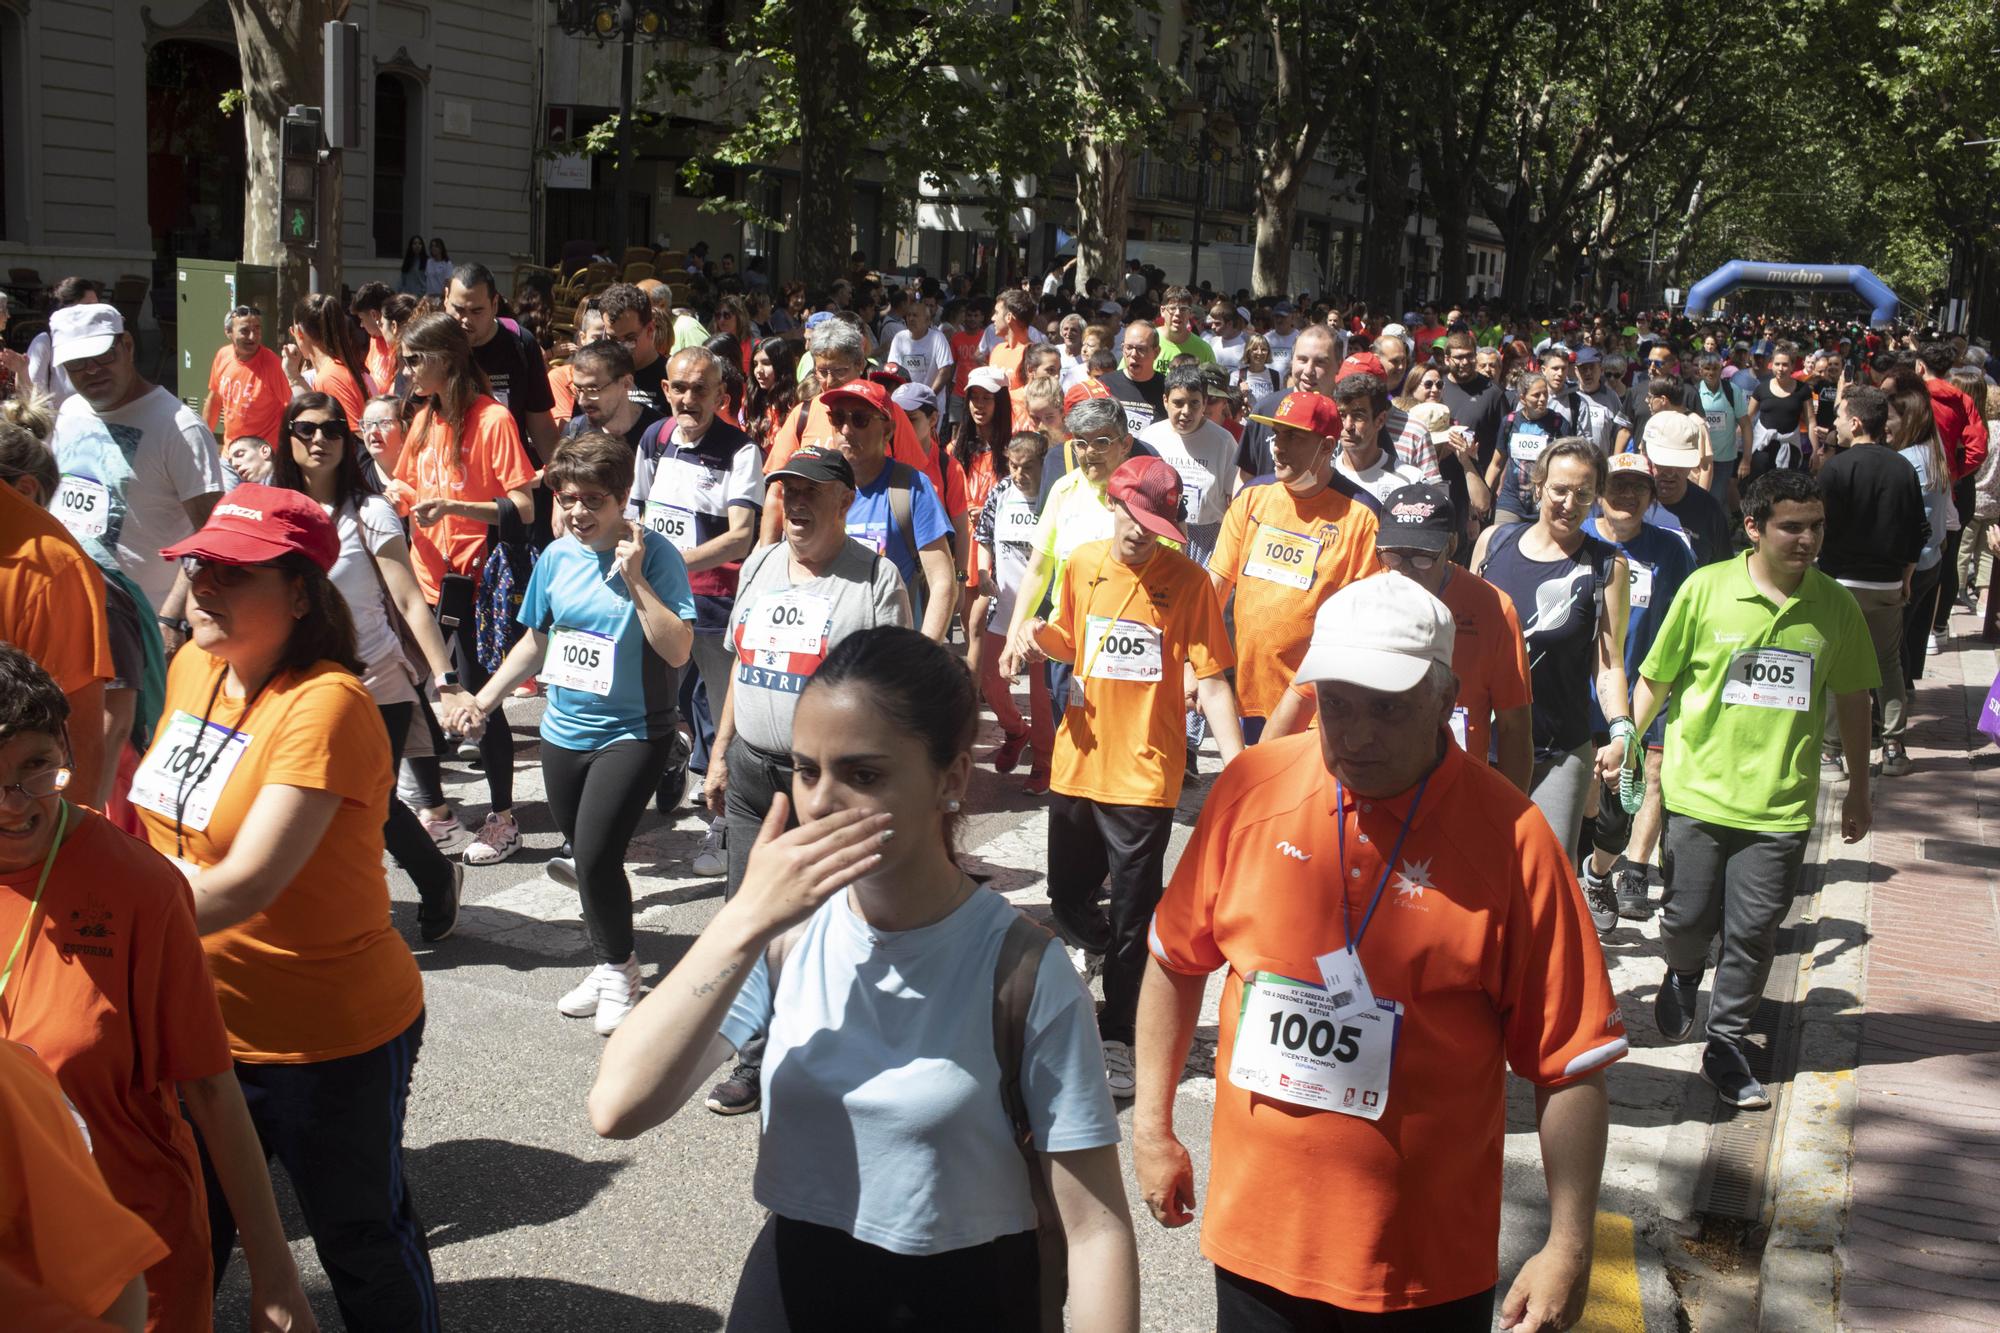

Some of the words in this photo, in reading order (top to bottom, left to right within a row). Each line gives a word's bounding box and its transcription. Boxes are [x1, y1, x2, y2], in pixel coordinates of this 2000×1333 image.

[1128, 419, 1142, 431] 05
[1707, 416, 1721, 424] 005
[1518, 441, 1540, 449] 1005
[62, 491, 96, 512] 1005
[1011, 513, 1040, 525] 1005
[1396, 514, 1424, 523] zero
[653, 518, 685, 536] 1005
[1266, 543, 1304, 564] 1005
[563, 645, 600, 668] 1005
[1744, 663, 1795, 684] 1005
[1276, 993, 1303, 1004] PERSONES
[1305, 999, 1317, 1007] AMB
[1300, 991, 1325, 1002] CARRERA
[1269, 1010, 1362, 1063] 1005
[1281, 1051, 1308, 1063] VICENTE
